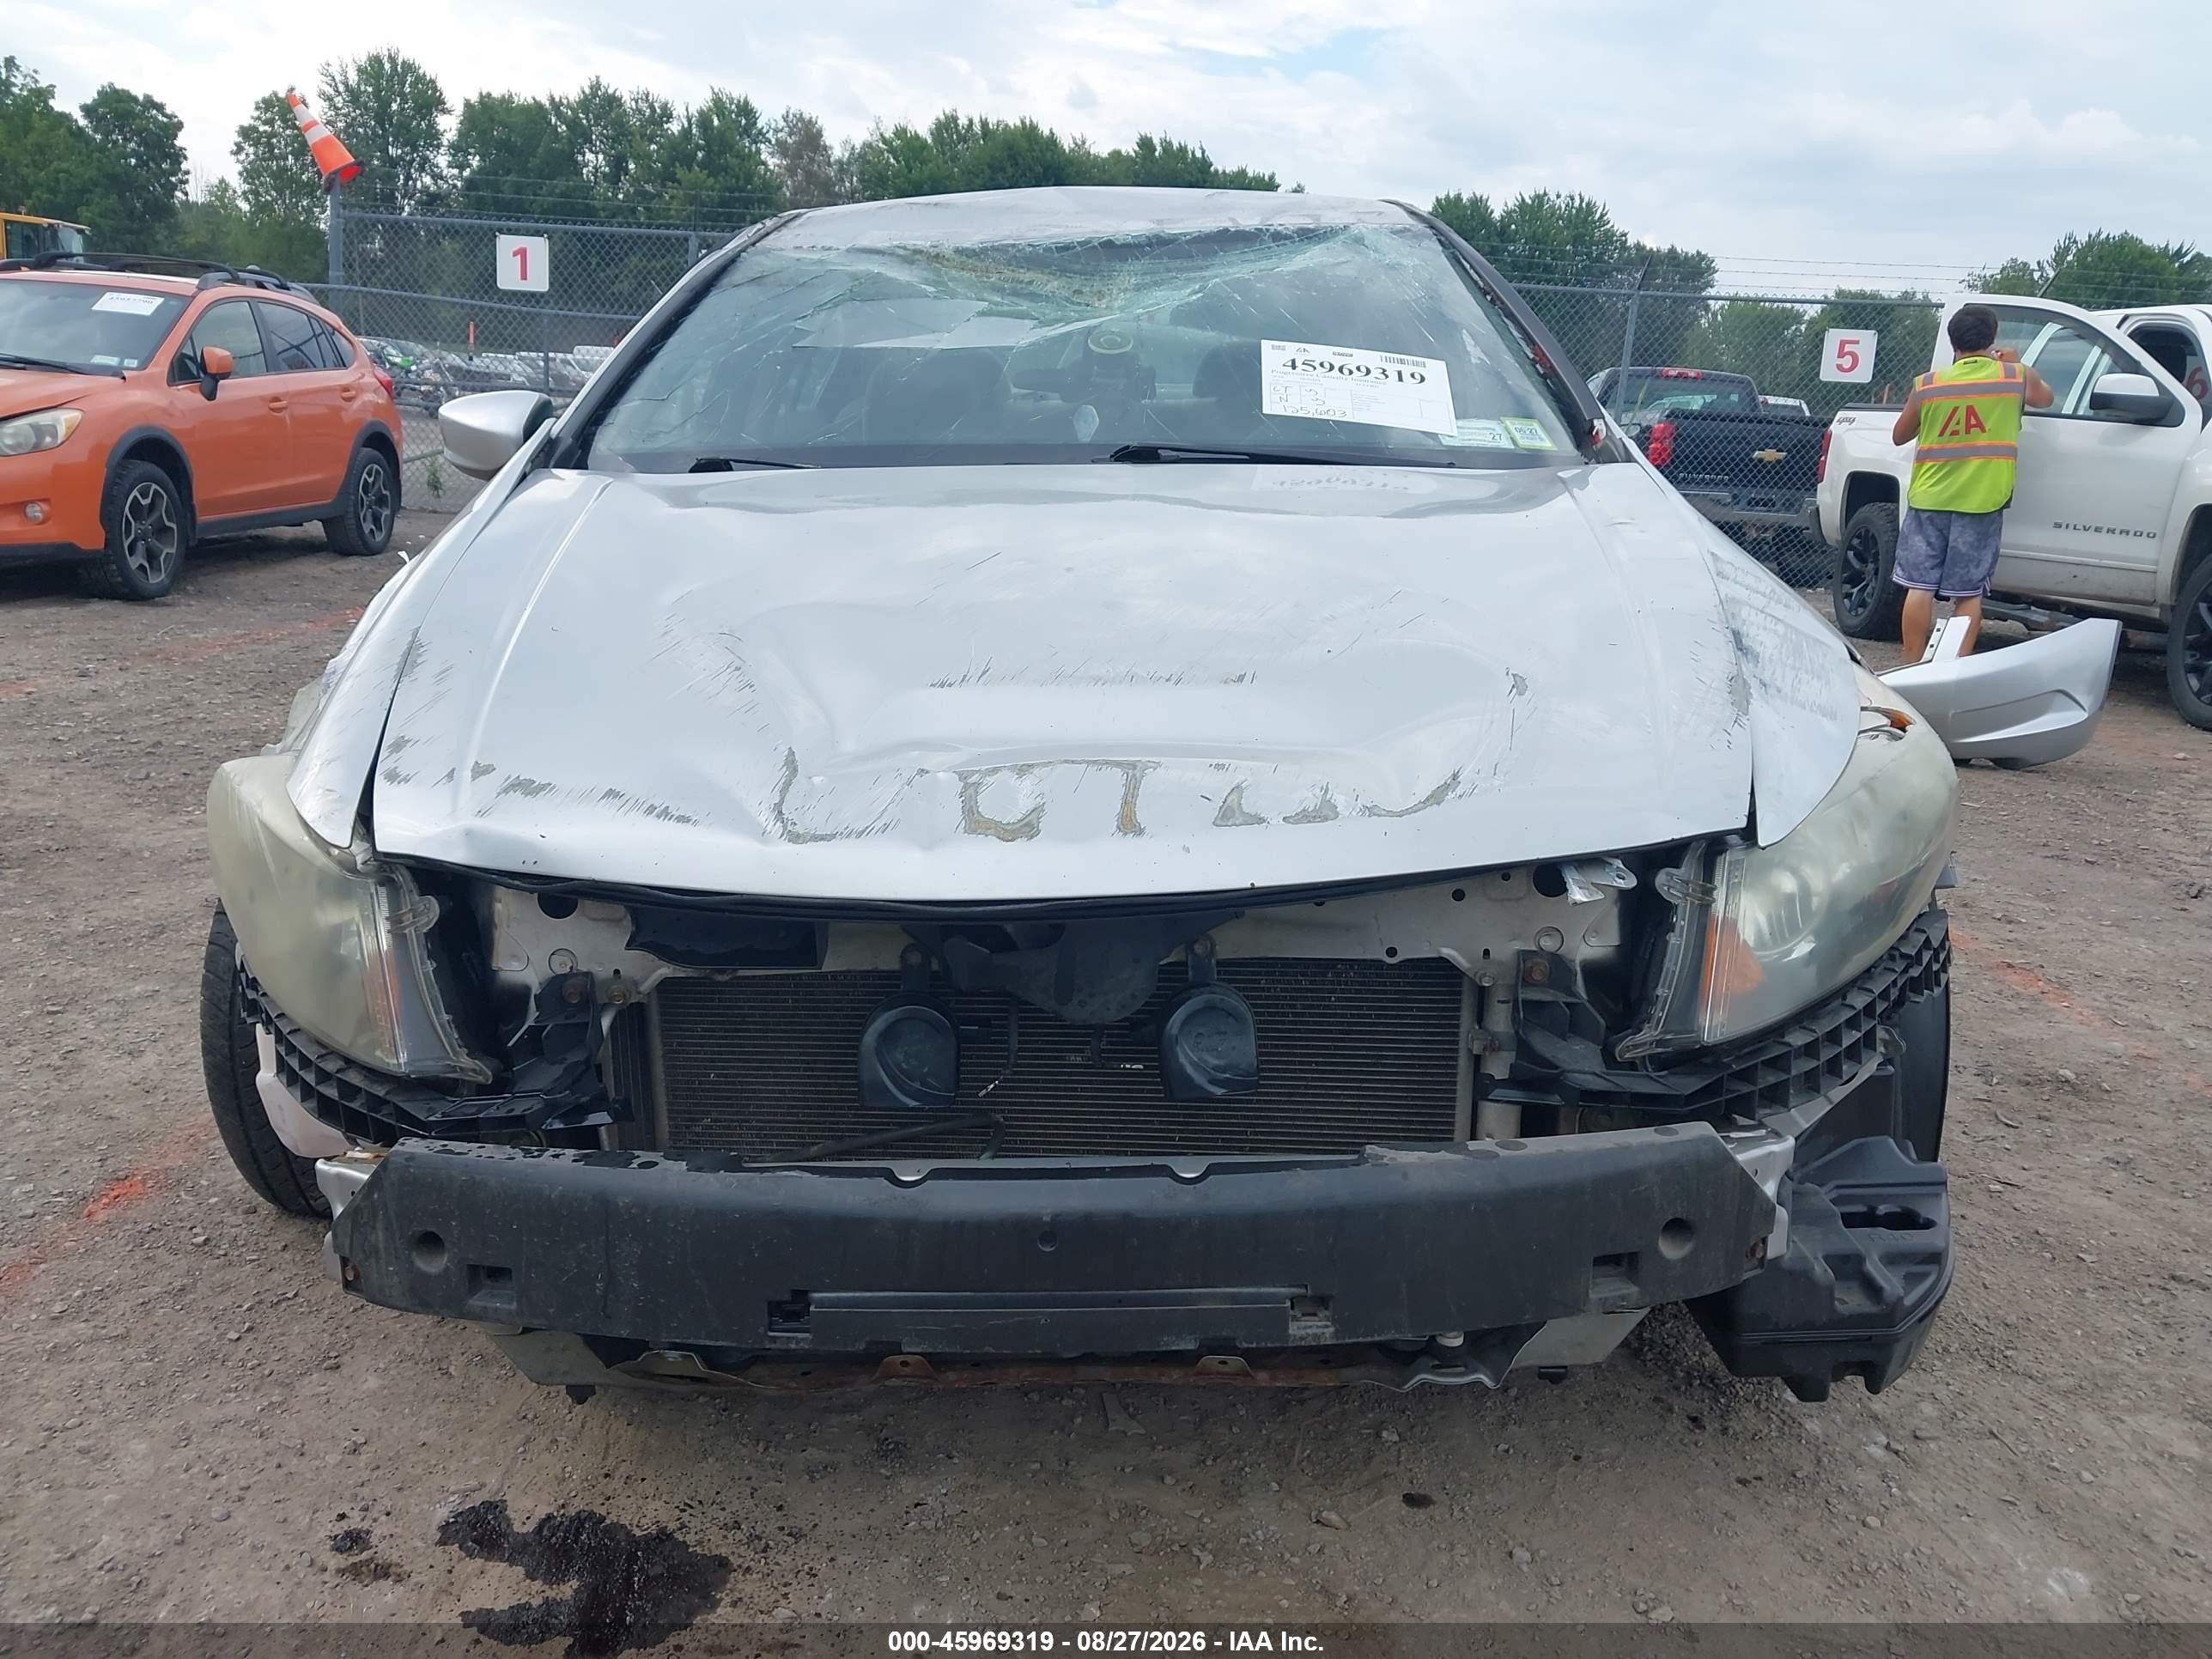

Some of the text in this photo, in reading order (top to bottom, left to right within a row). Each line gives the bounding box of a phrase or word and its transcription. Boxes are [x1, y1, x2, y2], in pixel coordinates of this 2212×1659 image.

[513, 247, 527, 281] 1
[1836, 339, 1860, 373] 5
[1282, 358, 1425, 385] 45969319
[2186, 367, 2209, 400] 6
[1490, 432, 1502, 441] 27
[2053, 521, 2157, 538] SILVERADO
